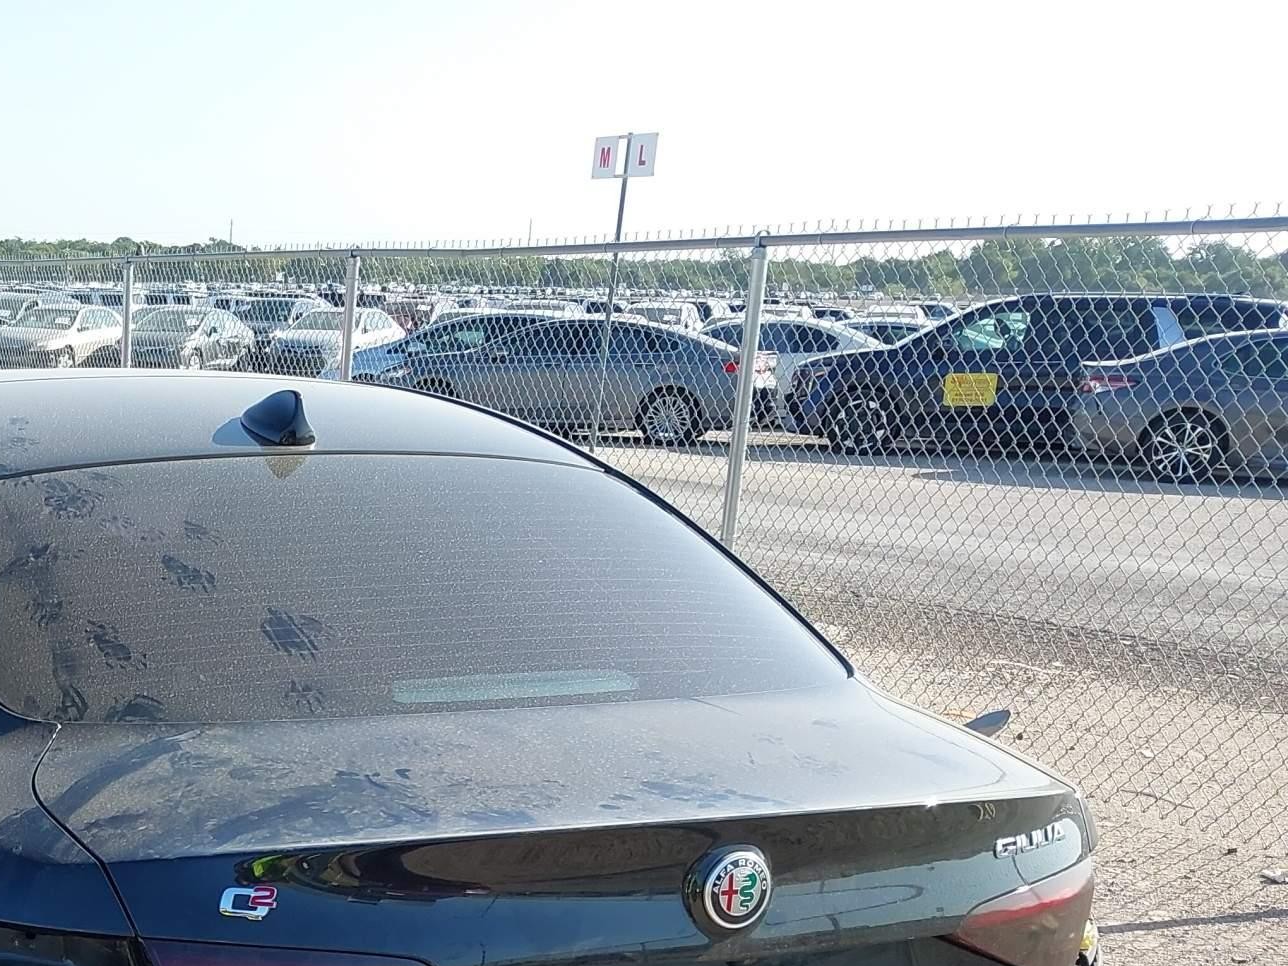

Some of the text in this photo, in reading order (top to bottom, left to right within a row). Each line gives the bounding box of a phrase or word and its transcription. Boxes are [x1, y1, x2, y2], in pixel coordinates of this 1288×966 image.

[599, 146, 611, 168] M
[638, 144, 646, 166] L
[995, 822, 1066, 857] GIULIA
[712, 859, 767, 894] ALFA ROMEO
